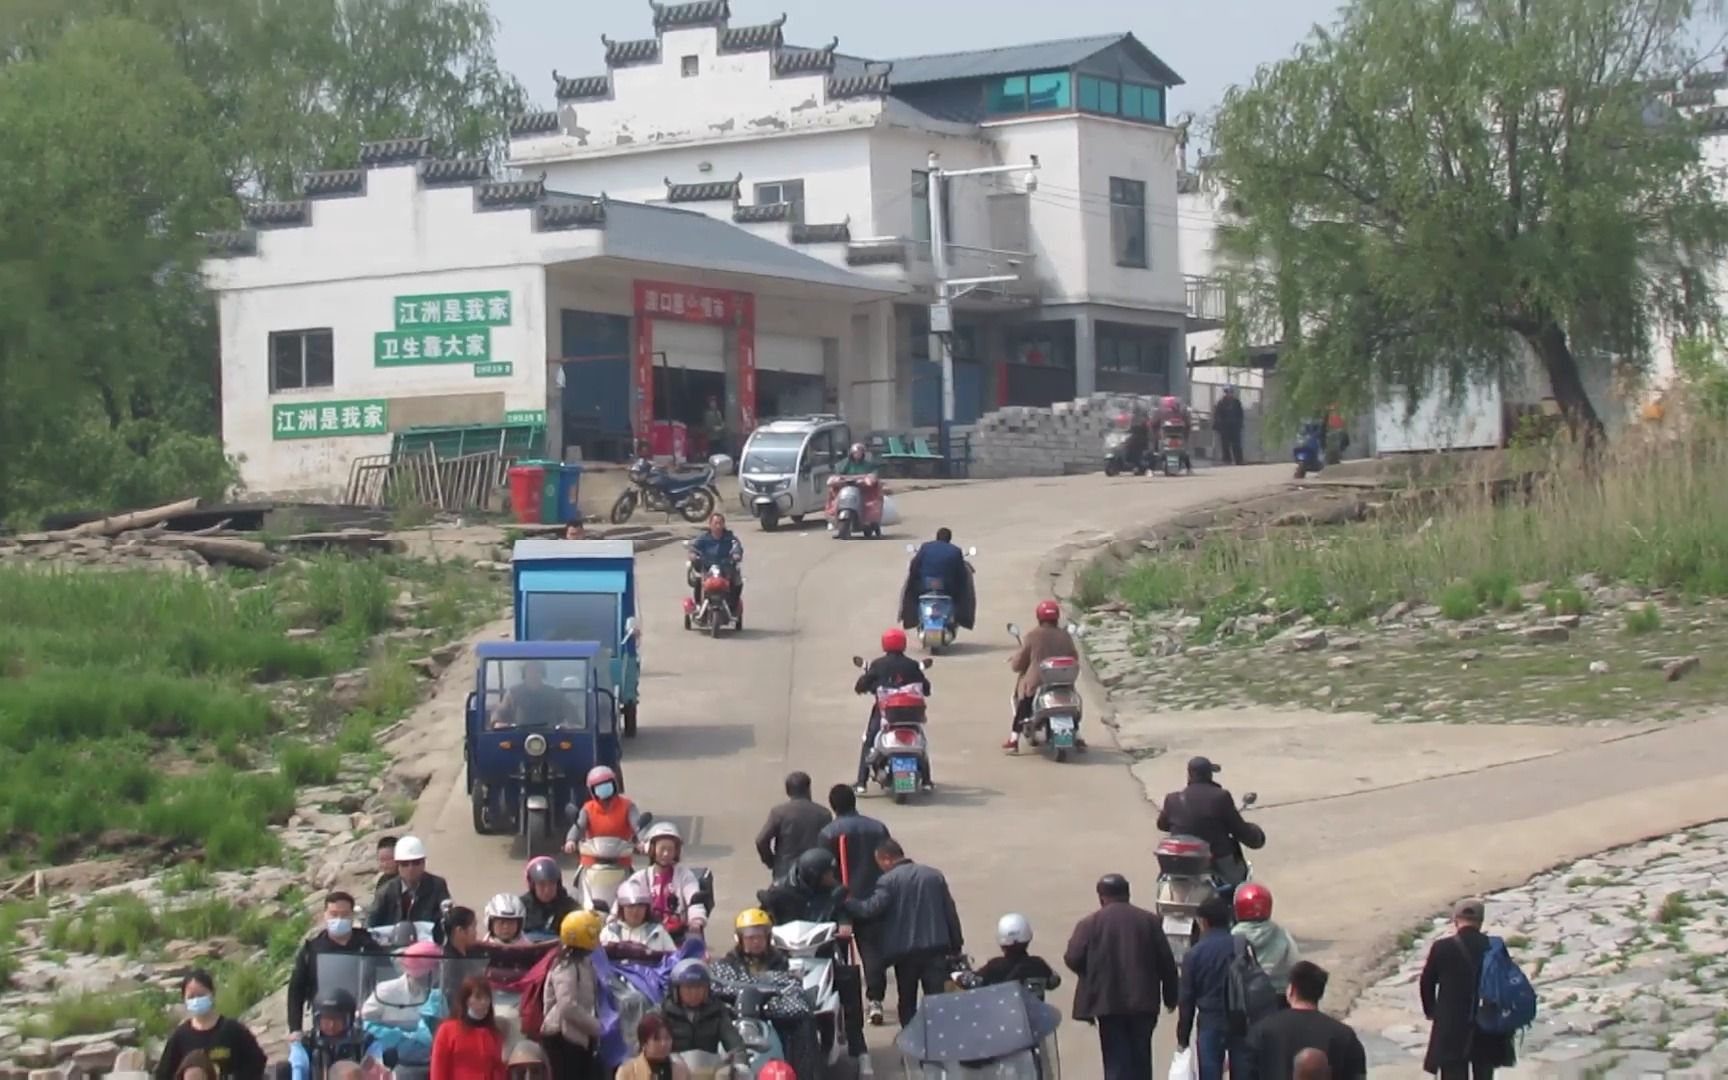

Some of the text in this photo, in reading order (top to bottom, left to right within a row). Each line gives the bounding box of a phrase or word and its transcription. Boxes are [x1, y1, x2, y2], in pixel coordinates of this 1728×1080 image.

[399, 296, 509, 323] 江洲是我家
[380, 334, 486, 360] 卫生靠大家
[276, 404, 384, 433] 江洲是我家
